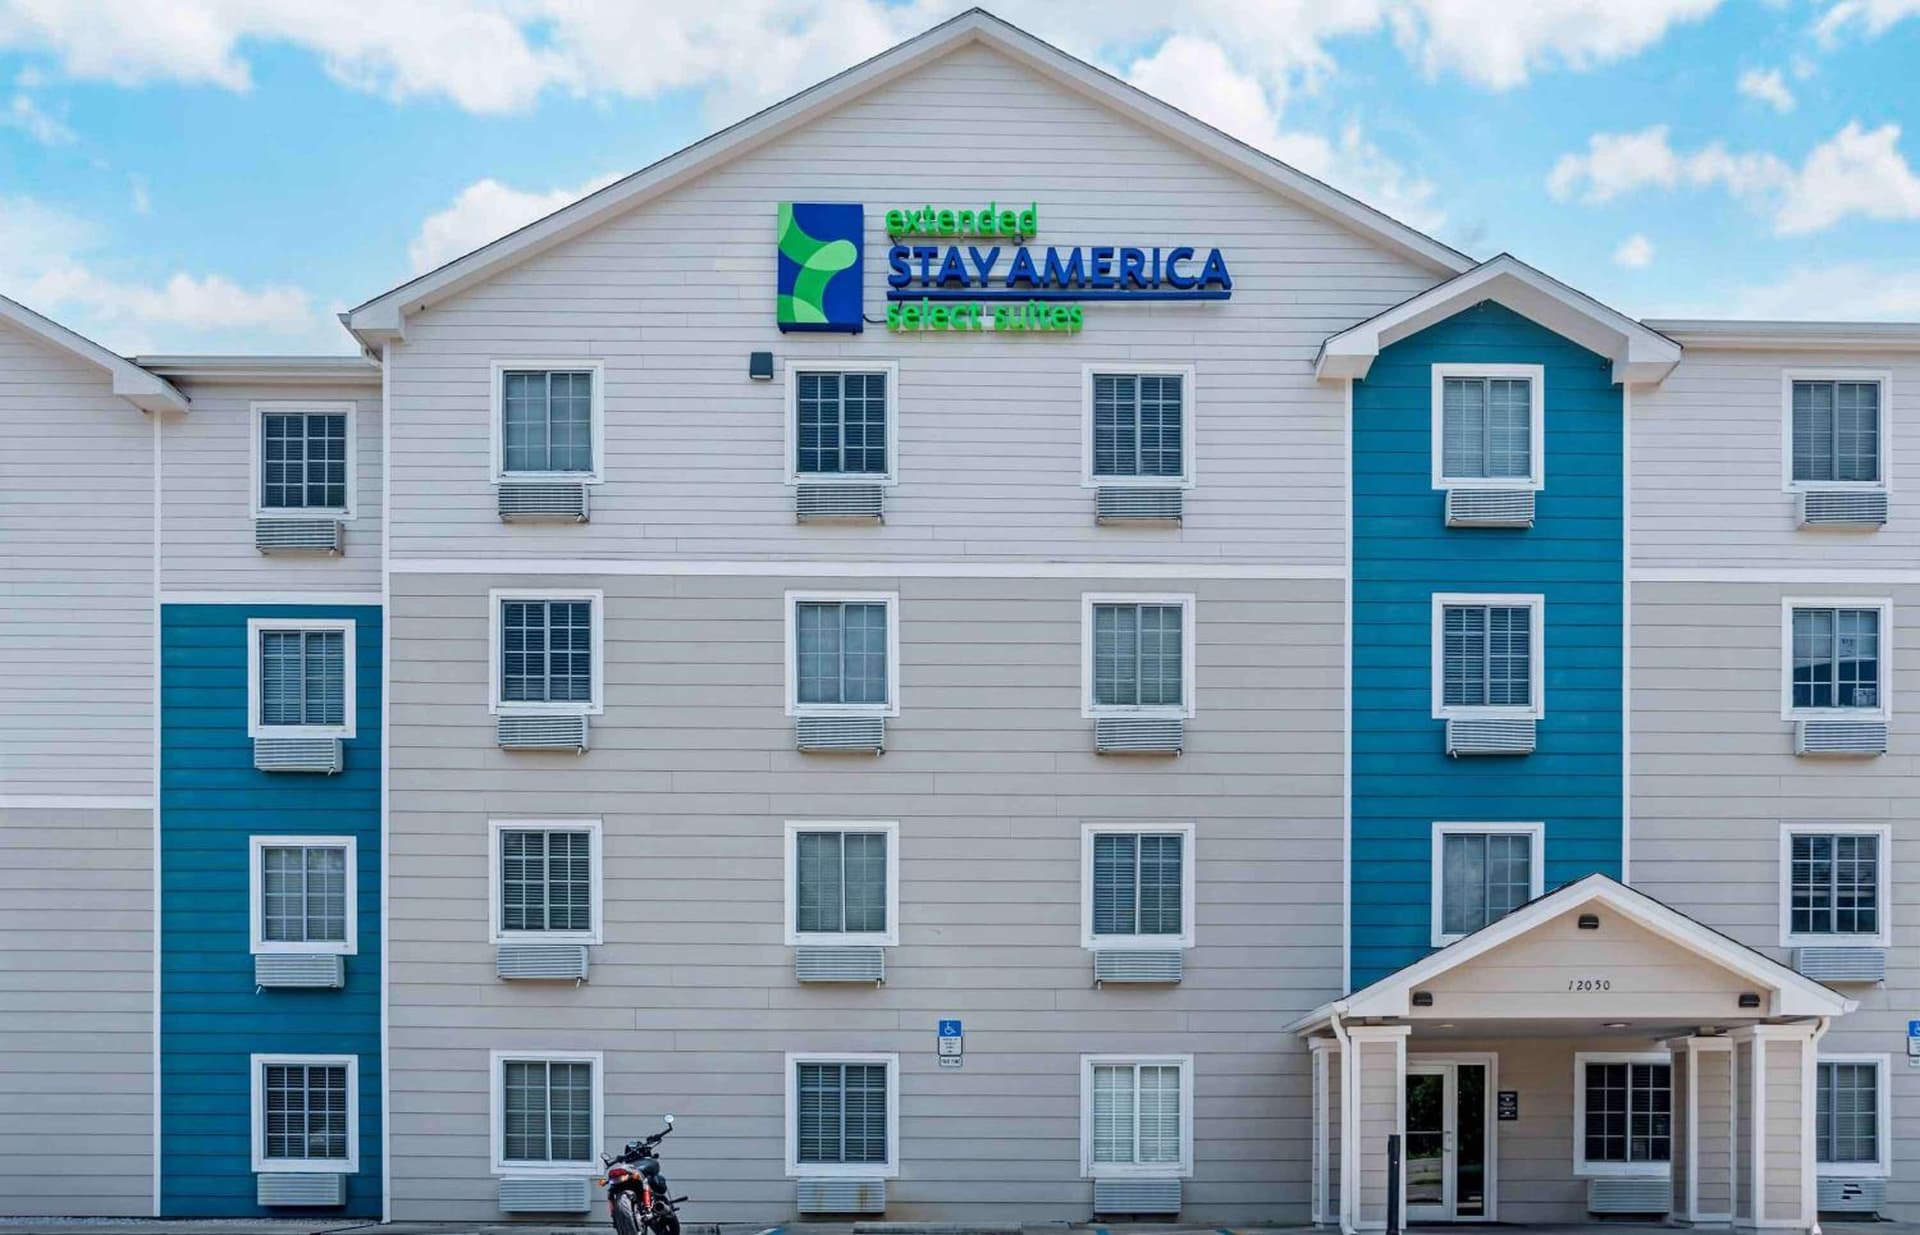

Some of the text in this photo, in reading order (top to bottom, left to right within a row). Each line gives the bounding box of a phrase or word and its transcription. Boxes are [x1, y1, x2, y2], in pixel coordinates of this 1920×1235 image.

[886, 202, 1037, 236] extended
[888, 246, 1232, 290] STAY AMERICA
[886, 298, 1083, 331] select suites
[1568, 980, 1610, 991] 12050
